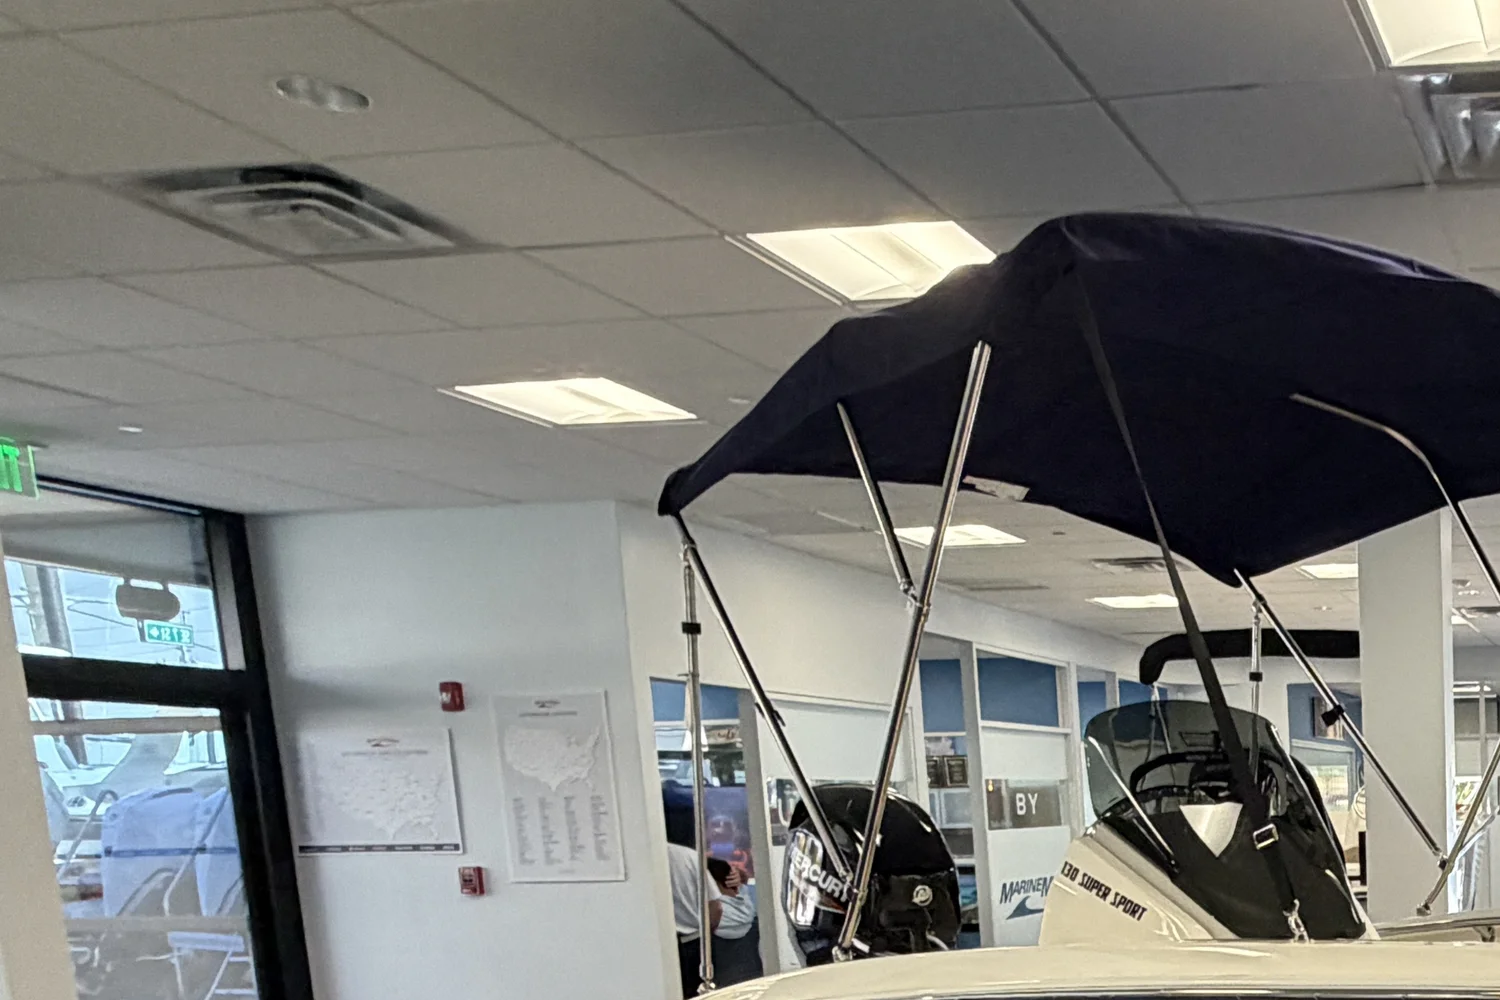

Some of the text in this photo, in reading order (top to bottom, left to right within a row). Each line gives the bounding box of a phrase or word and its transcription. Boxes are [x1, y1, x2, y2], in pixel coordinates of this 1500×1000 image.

[0, 443, 23, 493] IT
[1015, 792, 1039, 815] BY
[999, 875, 1055, 905] MARINEM
[1060, 860, 1149, 922] 130 SUPER SPORT
